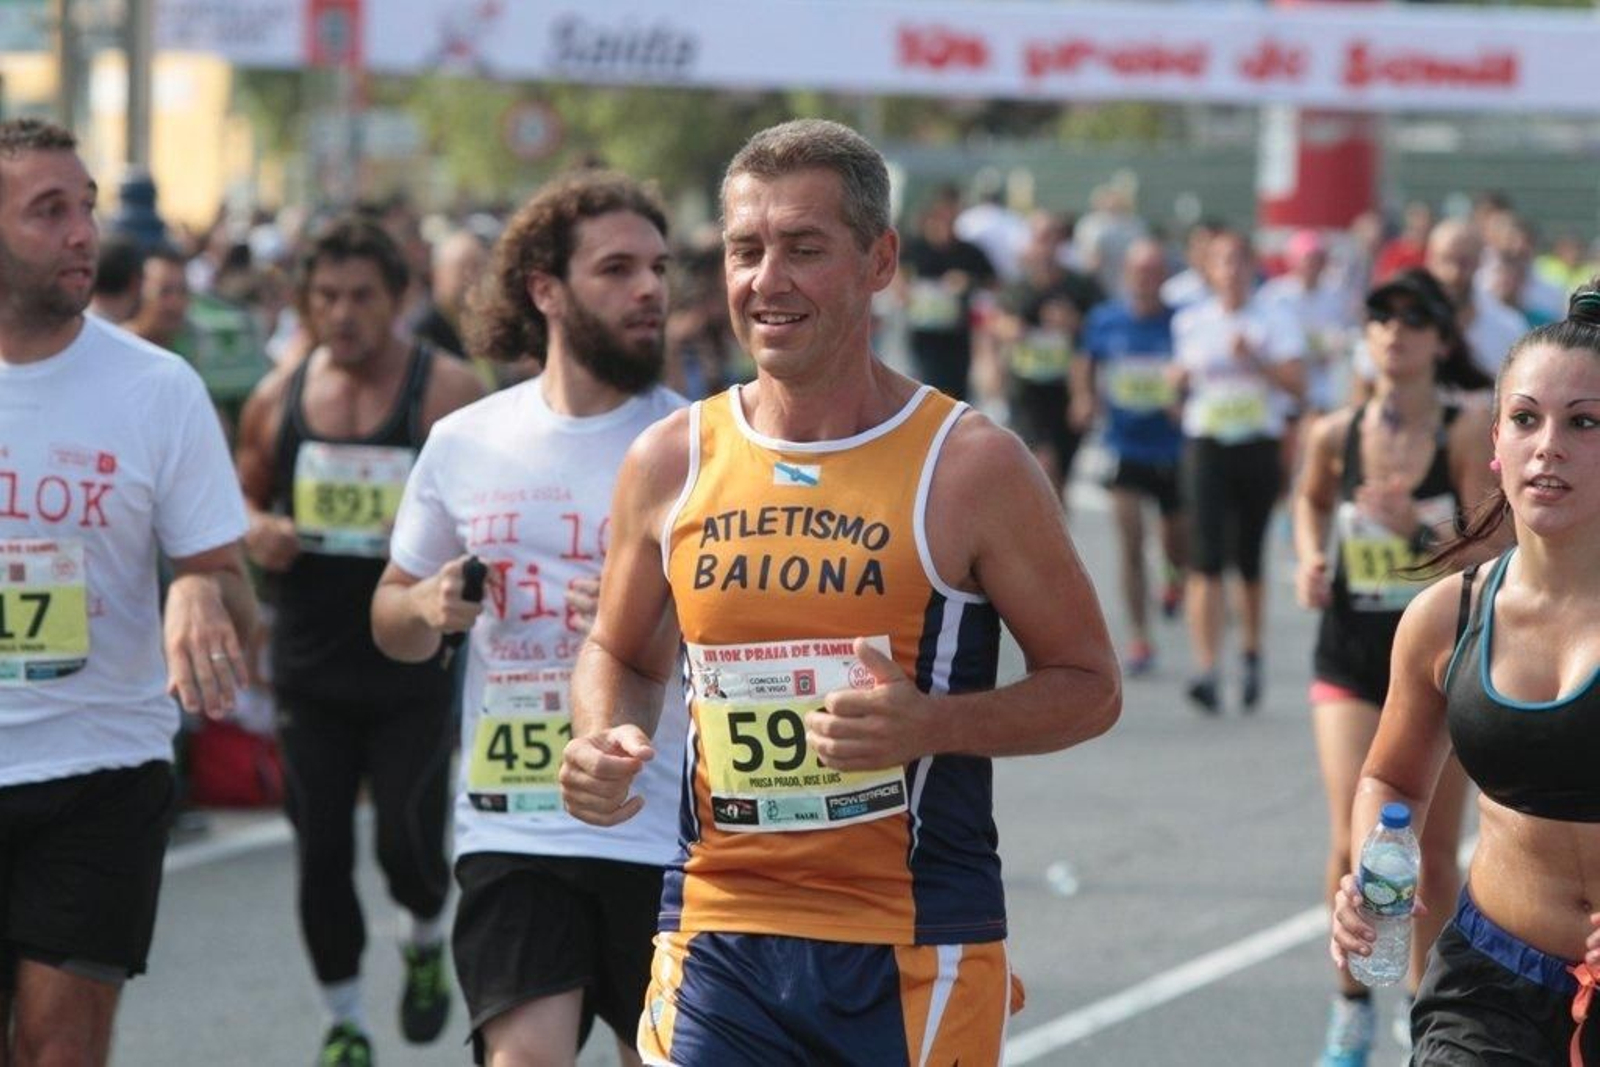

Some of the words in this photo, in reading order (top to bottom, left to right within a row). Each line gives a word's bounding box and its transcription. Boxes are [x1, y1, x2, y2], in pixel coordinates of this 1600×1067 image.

[315, 484, 384, 524] 891
[469, 511, 520, 547] III
[700, 506, 890, 551] ATLETISMO
[693, 554, 885, 596] BAIONA
[745, 645, 789, 661] PRAIA
[791, 644, 810, 658] DE
[749, 676, 791, 685] CONCELLO
[728, 708, 826, 772] 59
[822, 773, 842, 785] LUIS
[829, 785, 900, 808] POWERADE
